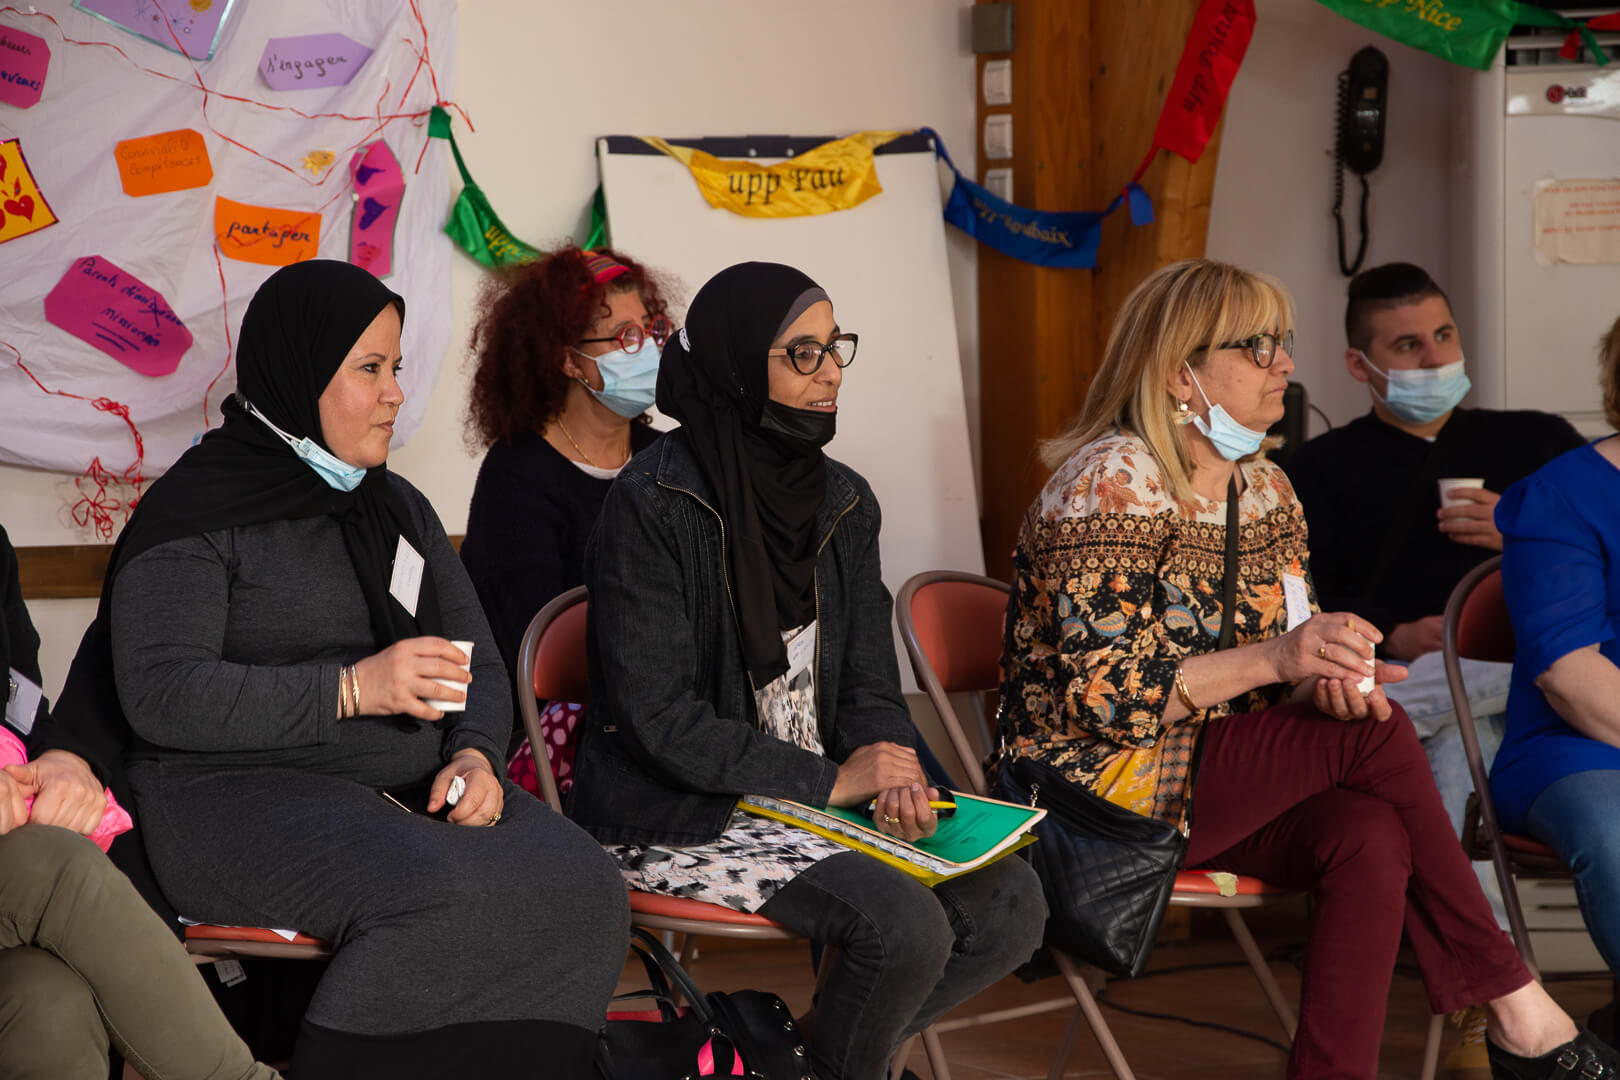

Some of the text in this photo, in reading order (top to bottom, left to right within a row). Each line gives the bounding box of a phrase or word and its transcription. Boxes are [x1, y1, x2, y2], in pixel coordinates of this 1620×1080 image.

[728, 166, 844, 205] upp Pau
[226, 220, 311, 248] partager
